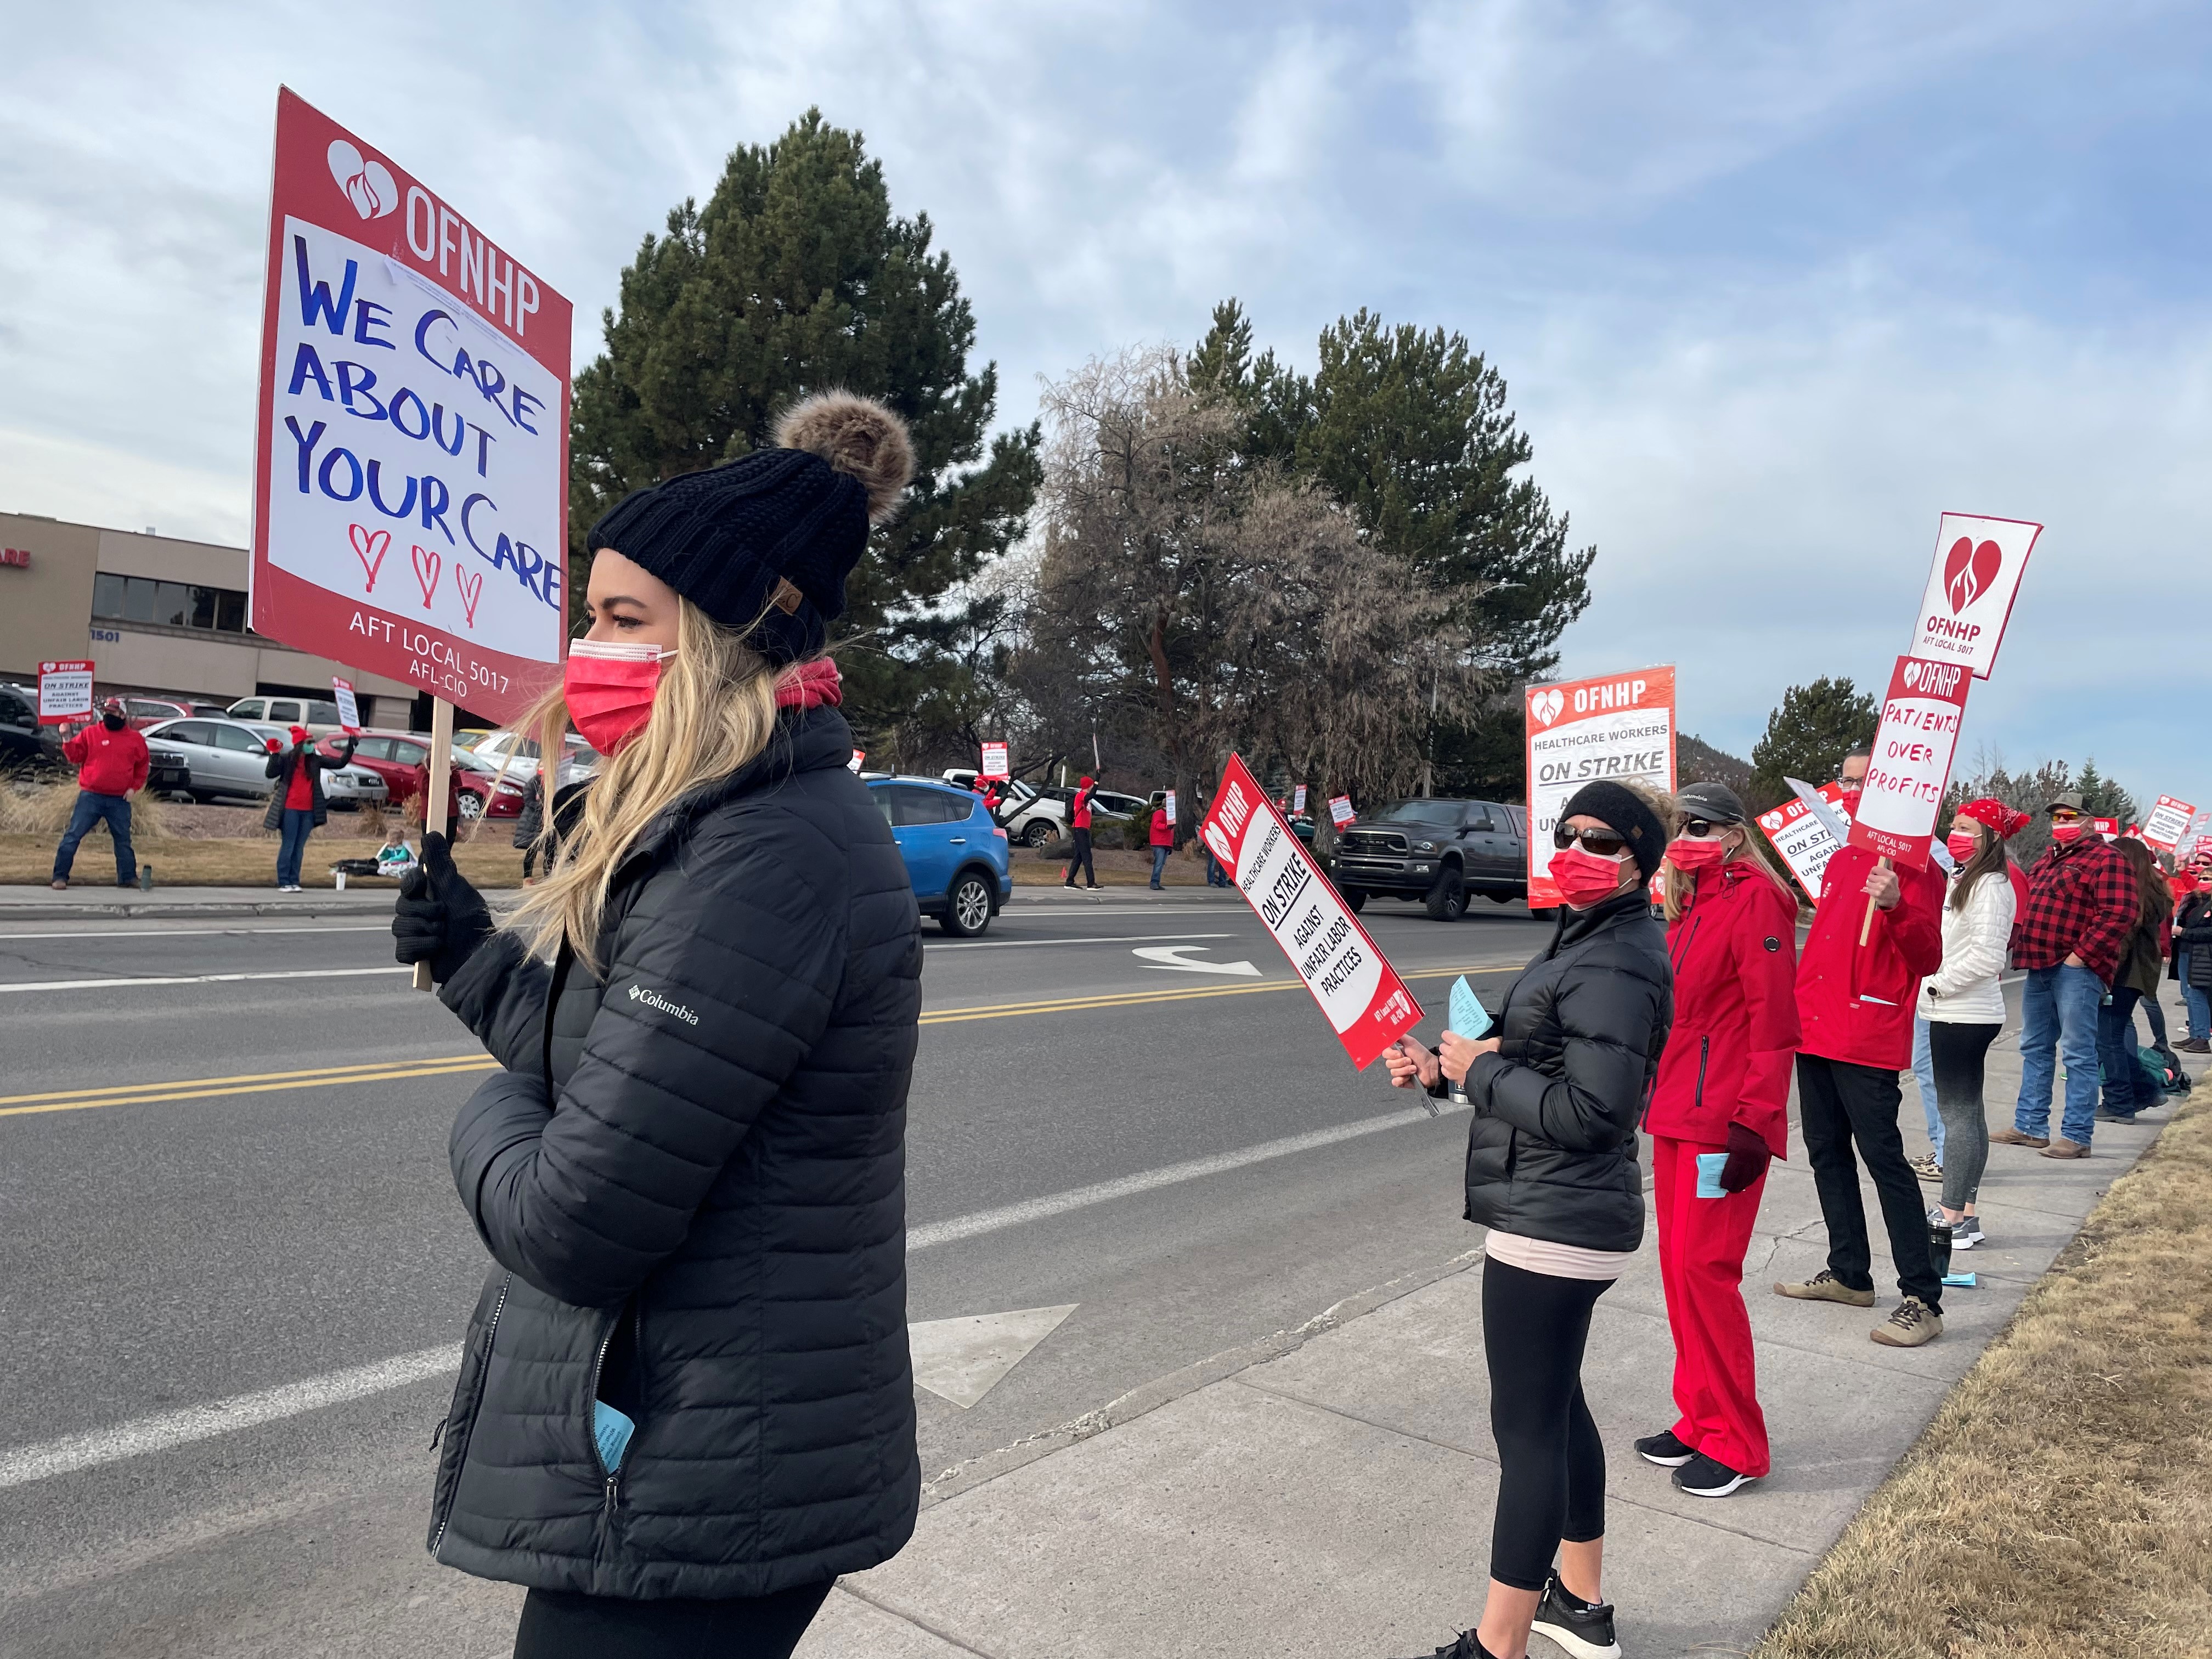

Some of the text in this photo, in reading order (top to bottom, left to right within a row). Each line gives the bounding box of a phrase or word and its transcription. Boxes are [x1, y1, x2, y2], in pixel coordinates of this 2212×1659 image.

[405, 185, 540, 337] OFNHP
[294, 234, 396, 350] WE
[415, 309, 546, 436] CARE
[287, 342, 496, 478] ABOUT
[284, 415, 567, 612] YOUR CARE
[91, 629, 120, 642] 1501
[1923, 635, 1974, 655] AFT LOCAL 5017
[1927, 616, 1981, 642] OFNHP
[349, 611, 509, 695] AFT LOCAL 5017
[409, 659, 467, 698] AFL-CIO
[1918, 662, 1962, 698] OFNHP
[1574, 679, 1646, 713] OFNHP
[1884, 703, 1958, 733] PATIENTS
[1534, 724, 1668, 751] HEALTHCARE WORKERS
[1888, 741, 1933, 766] OVER
[1539, 750, 1664, 782] ON STRIKE
[1866, 768, 1939, 803] PROFITS
[1218, 780, 1249, 838] OFNHP
[1786, 790, 1829, 817] OFP
[1775, 819, 1819, 843] HEALTHCARE
[1866, 830, 1912, 853] AFT LOCAL 5017
[2094, 821, 2110, 832] NHP
[1240, 822, 1282, 894] HEALTHCARE WORKERS
[1787, 839, 1807, 855] ON
[1809, 843, 1842, 862] AGAIN
[1877, 844, 1897, 856] AFL-CIO
[1801, 859, 1830, 877] UNFA
[1262, 851, 1307, 925] ON STRIKE
[1293, 904, 1324, 950] AGAINST
[1300, 916, 1352, 980] UNFAIR LABOR
[1321, 946, 1362, 997] PRACTICES
[639, 989, 699, 1025] Columbia
